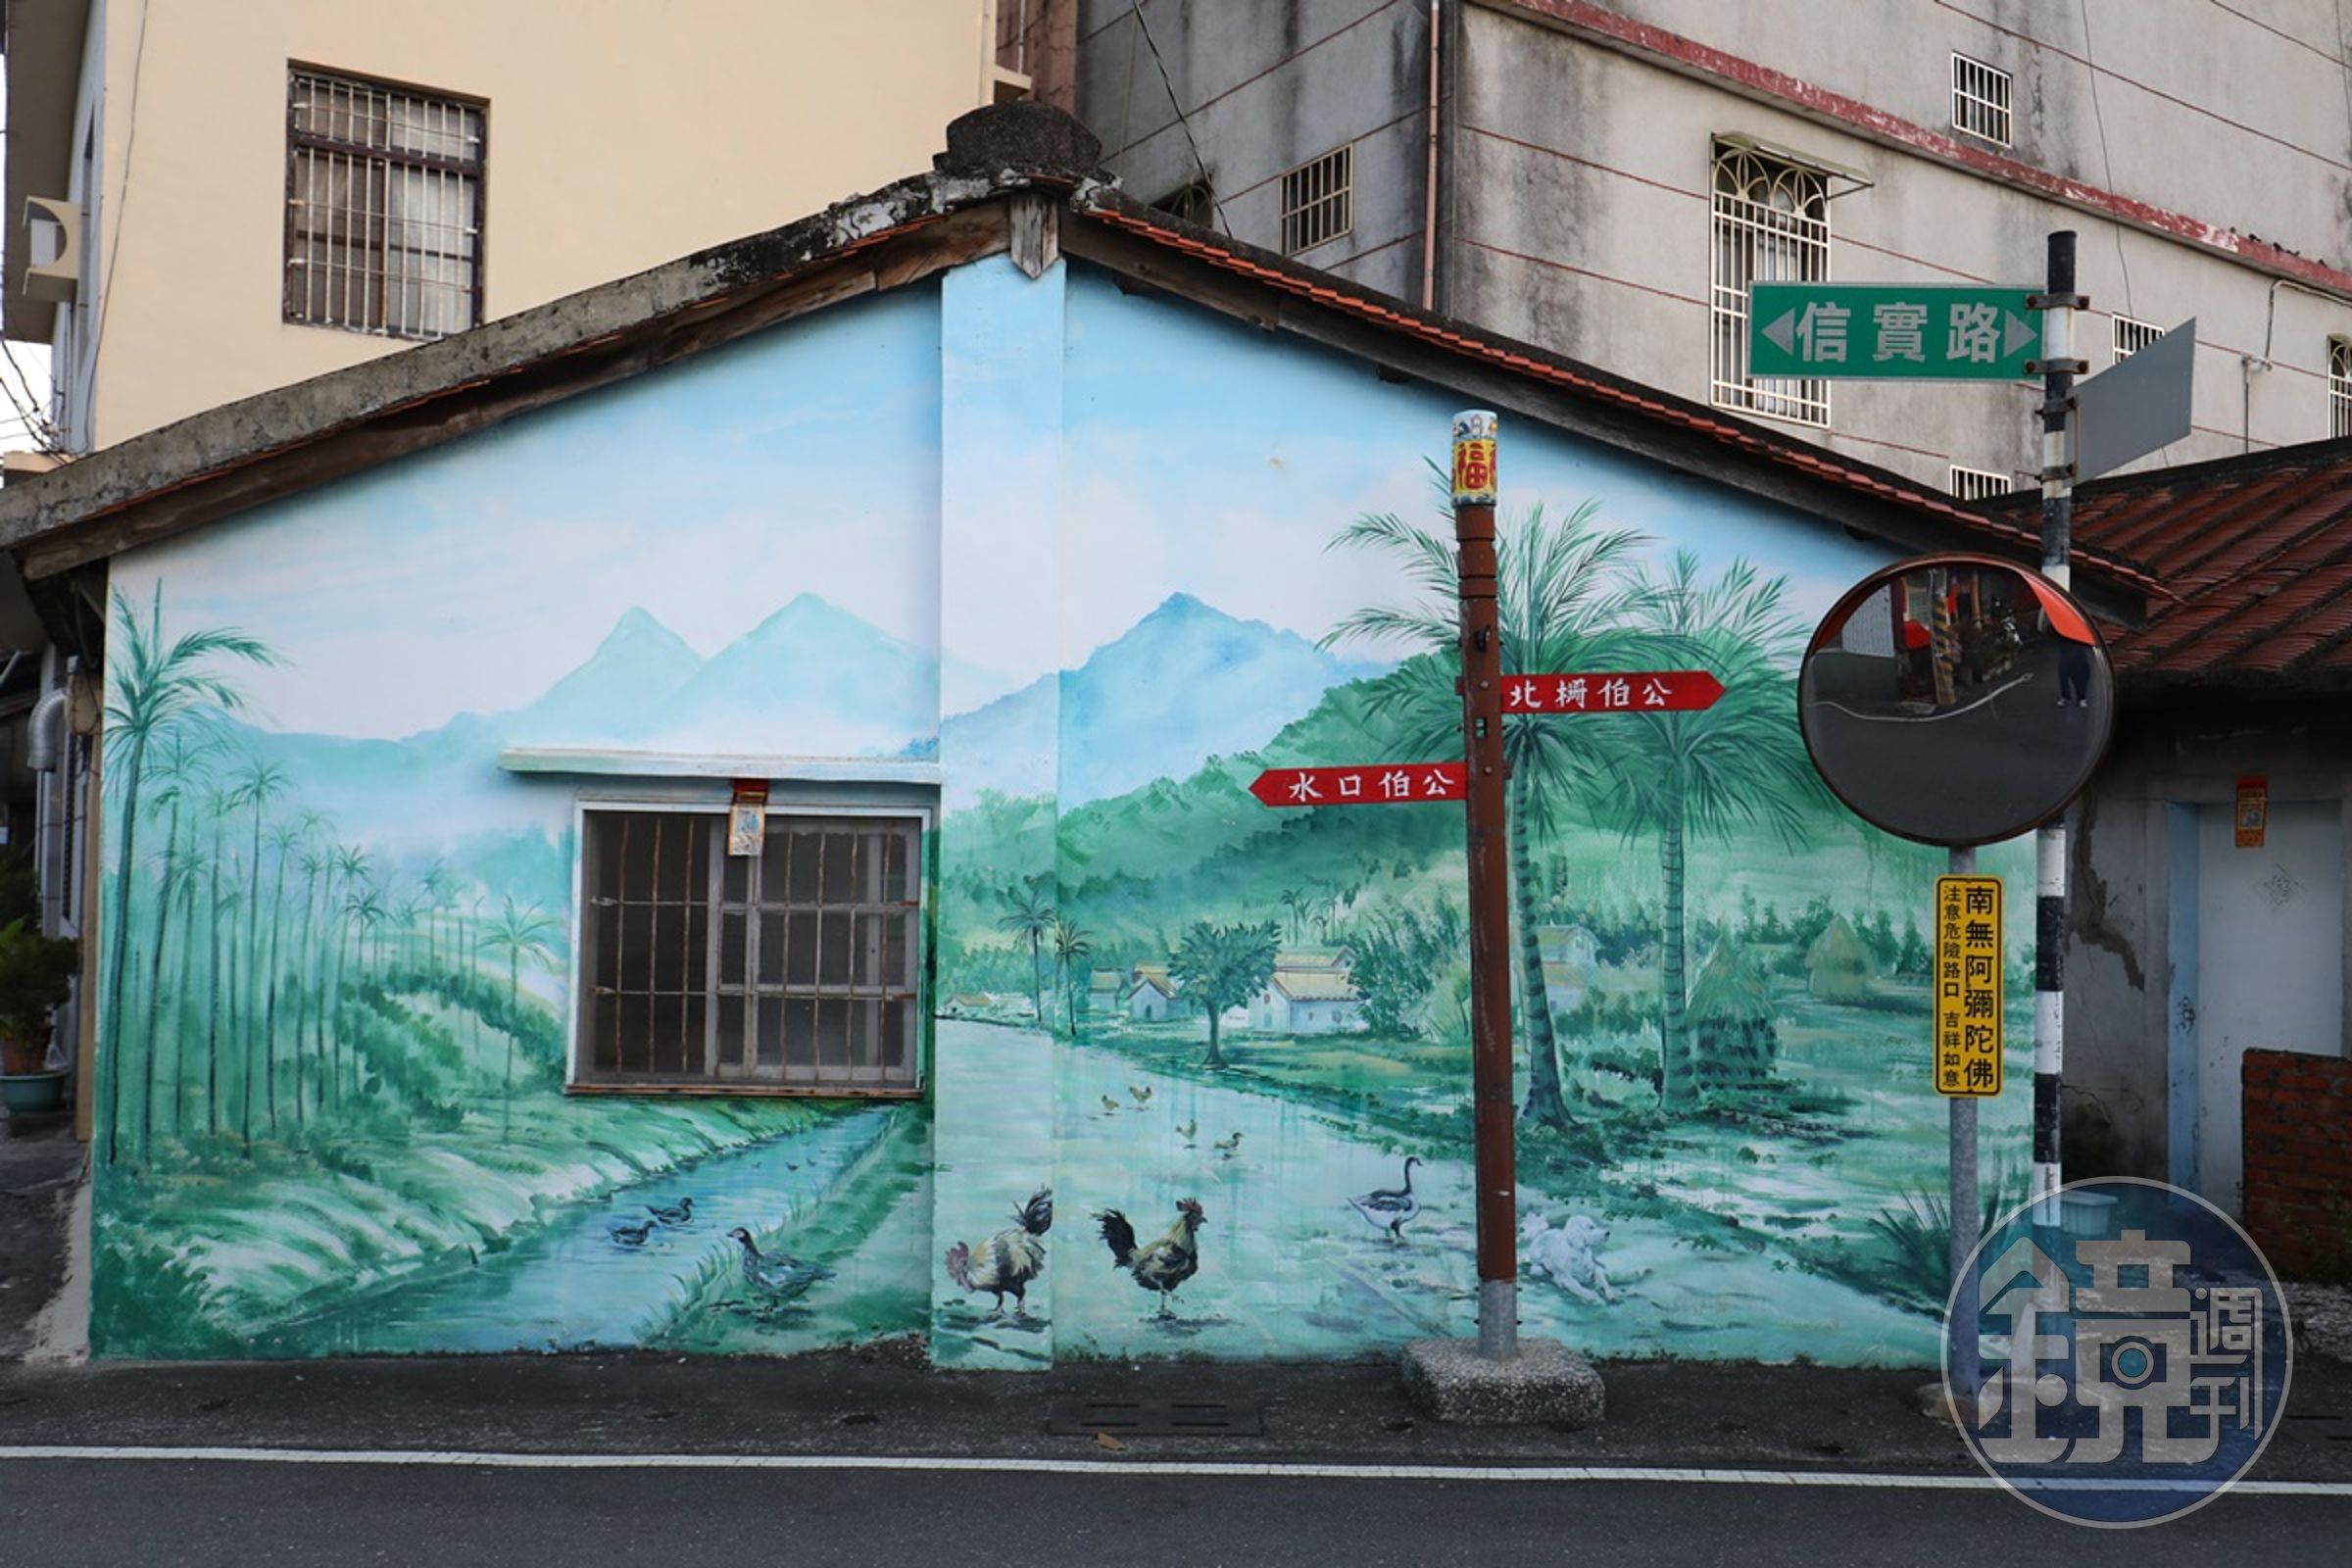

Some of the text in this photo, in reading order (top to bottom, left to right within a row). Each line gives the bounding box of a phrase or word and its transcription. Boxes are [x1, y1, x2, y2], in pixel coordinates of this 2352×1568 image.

[1795, 301, 2001, 363] 信實路
[1289, 768, 1455, 803] 水口伯公
[1942, 885, 1961, 1087] 注意危險路口 吉祥如意
[1963, 886, 1994, 1089] 南無阿彌陀佛
